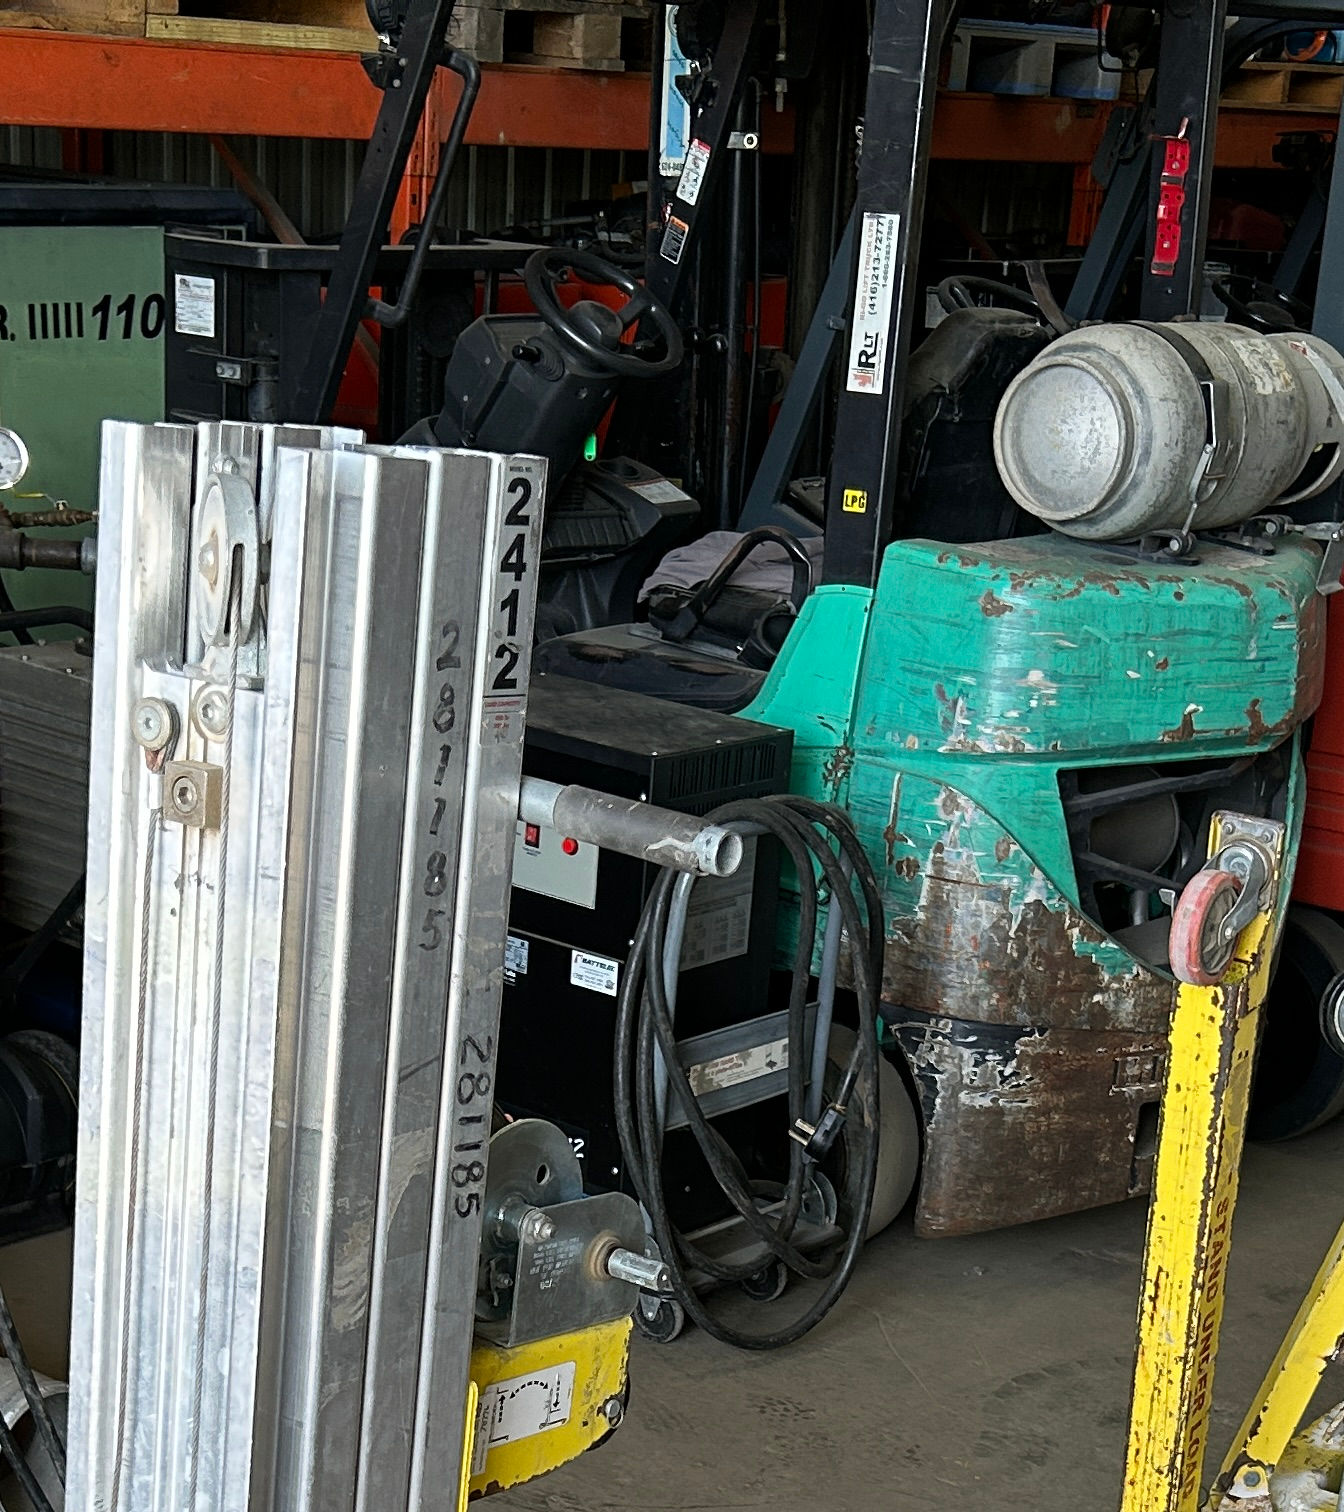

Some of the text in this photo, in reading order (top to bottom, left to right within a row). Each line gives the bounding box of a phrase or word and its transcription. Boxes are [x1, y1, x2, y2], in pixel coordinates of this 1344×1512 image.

[92, 294, 165, 341] 110
[845, 494, 866, 508] LPG
[492, 477, 533, 690] 2412
[451, 1034, 493, 1218] 281185
[1207, 1196, 1230, 1303] STAND
[1182, 1419, 1203, 1501] LOAD
